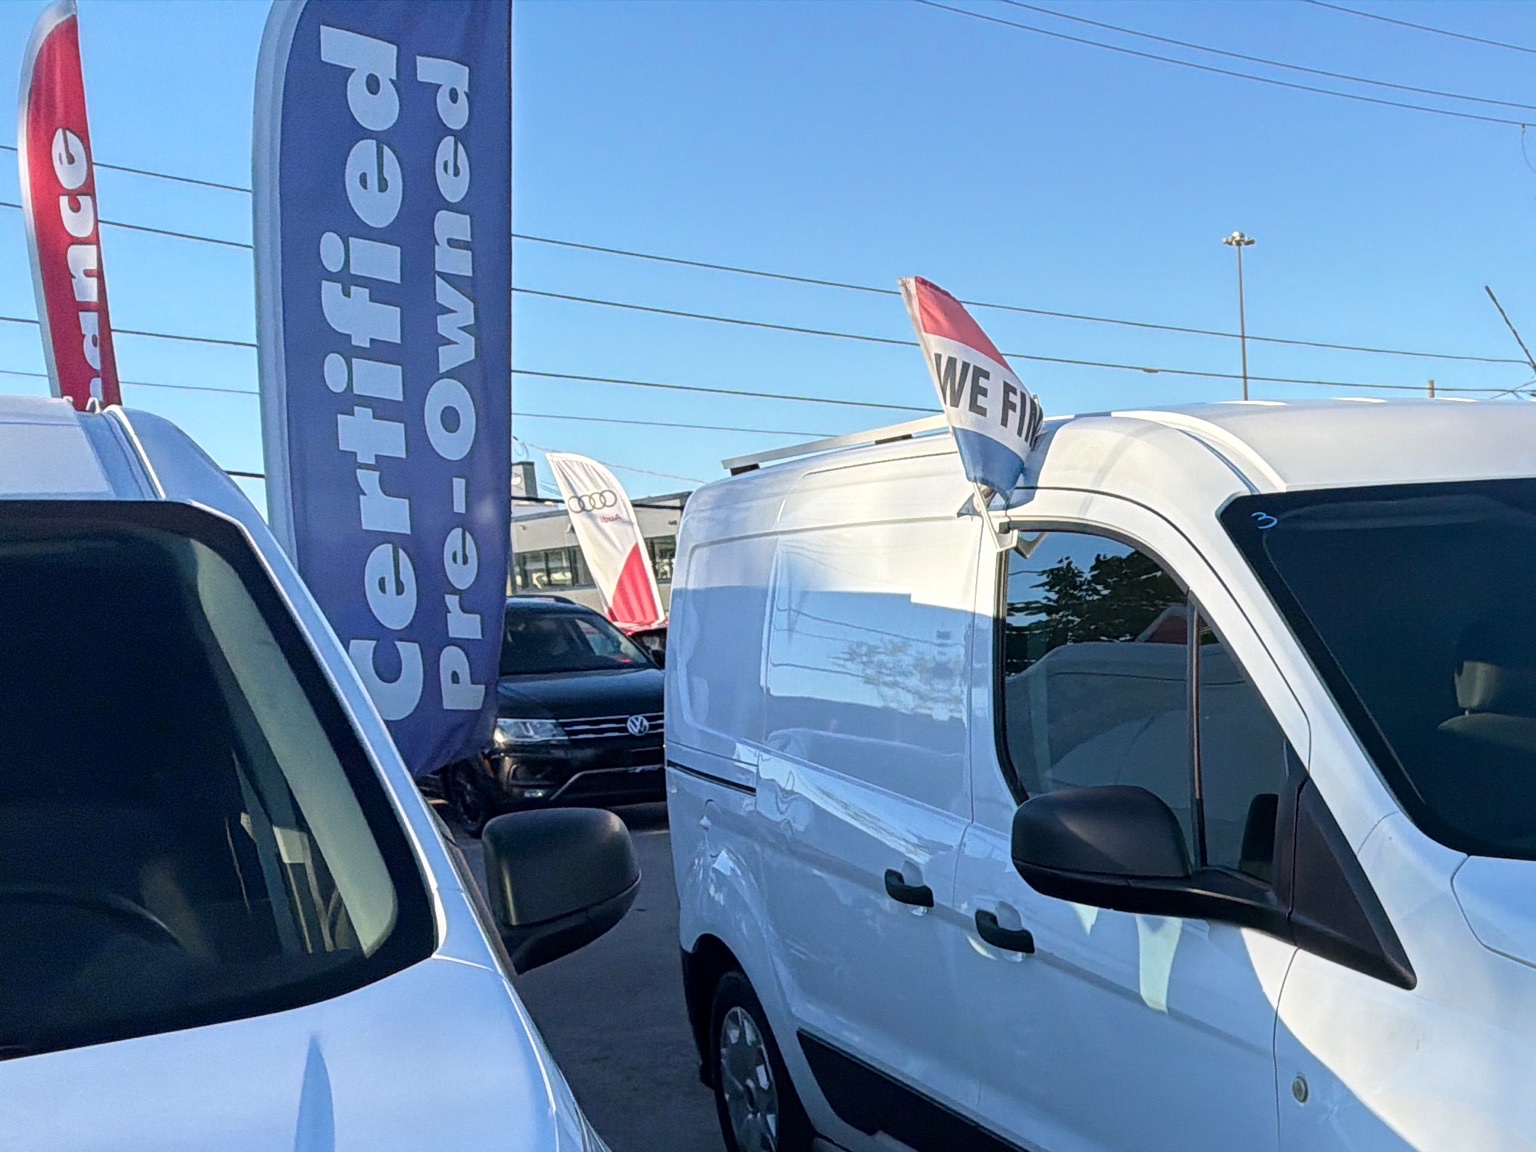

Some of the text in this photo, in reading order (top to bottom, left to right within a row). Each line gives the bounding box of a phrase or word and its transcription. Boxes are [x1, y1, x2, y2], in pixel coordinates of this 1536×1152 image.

[318, 24, 424, 722] Certified
[415, 54, 487, 711] Pre-Owned
[934, 352, 991, 418] WE
